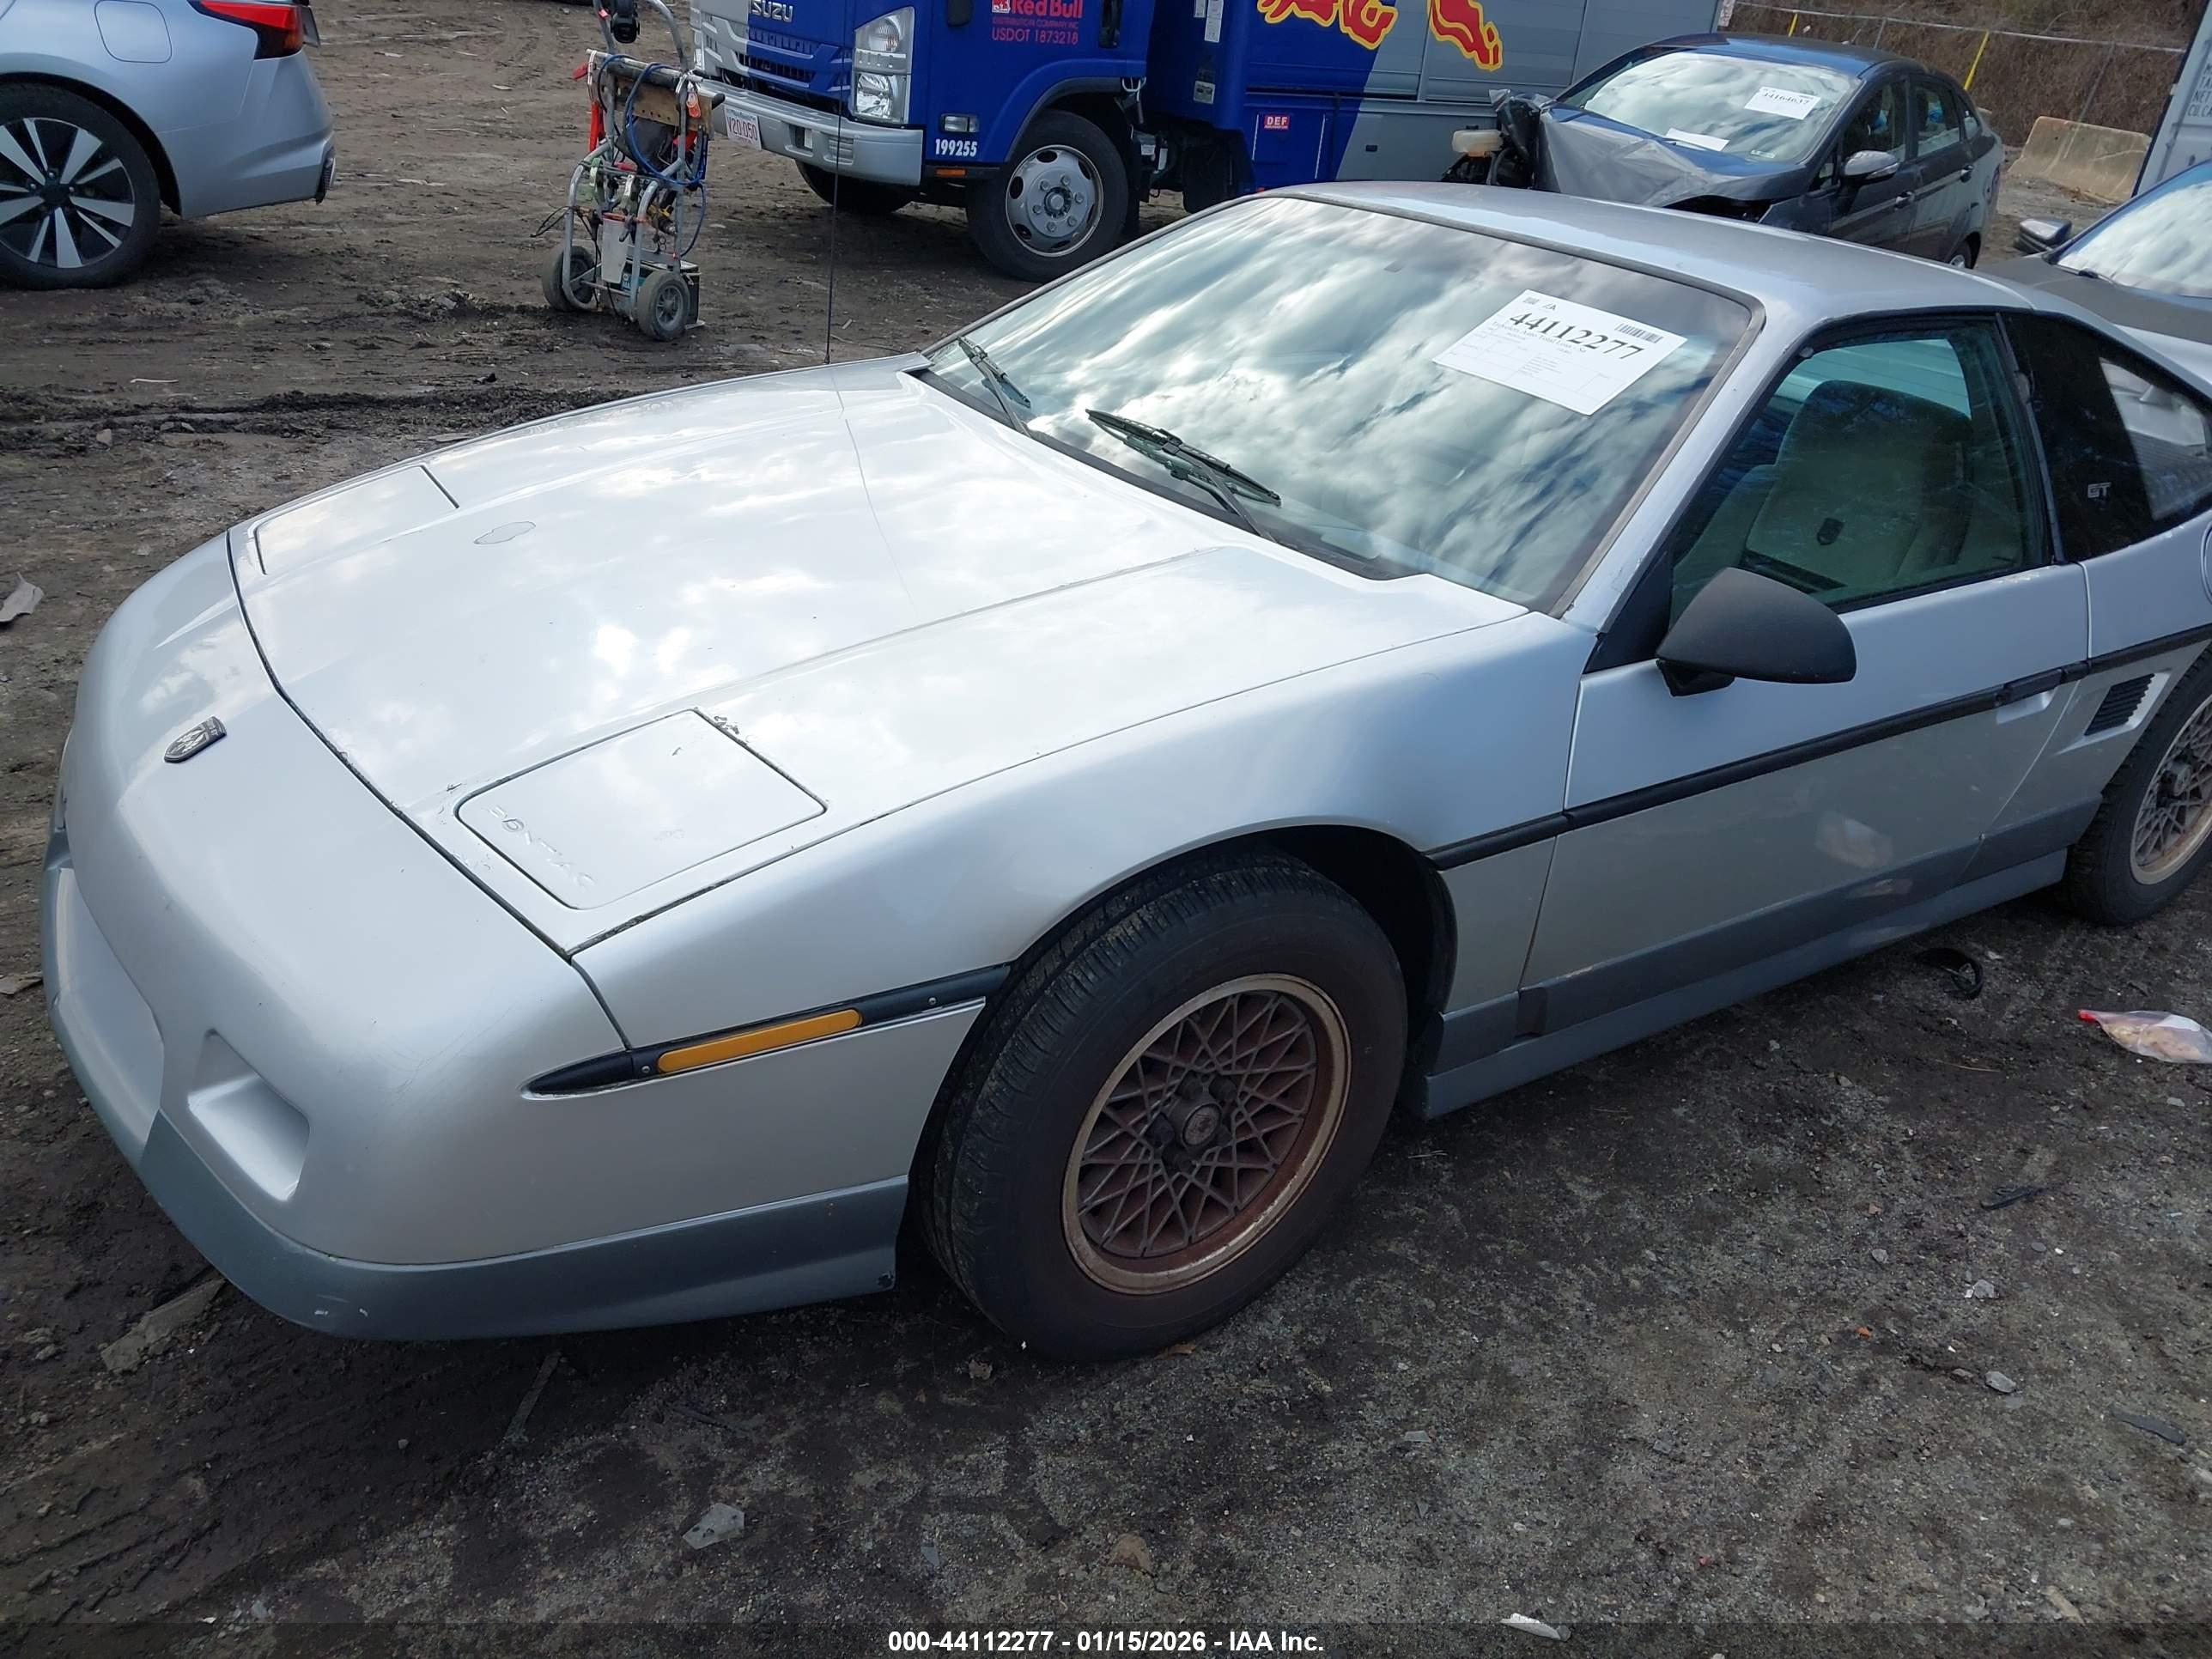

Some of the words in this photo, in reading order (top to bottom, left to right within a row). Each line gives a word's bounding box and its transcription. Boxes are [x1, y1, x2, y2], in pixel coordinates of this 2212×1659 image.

[748, 0, 793, 22] ISUZU
[992, 27, 1030, 42] USDOT
[1267, 116, 1288, 125] DEF
[935, 138, 978, 157] 199255
[1510, 313, 1644, 359] 44112277
